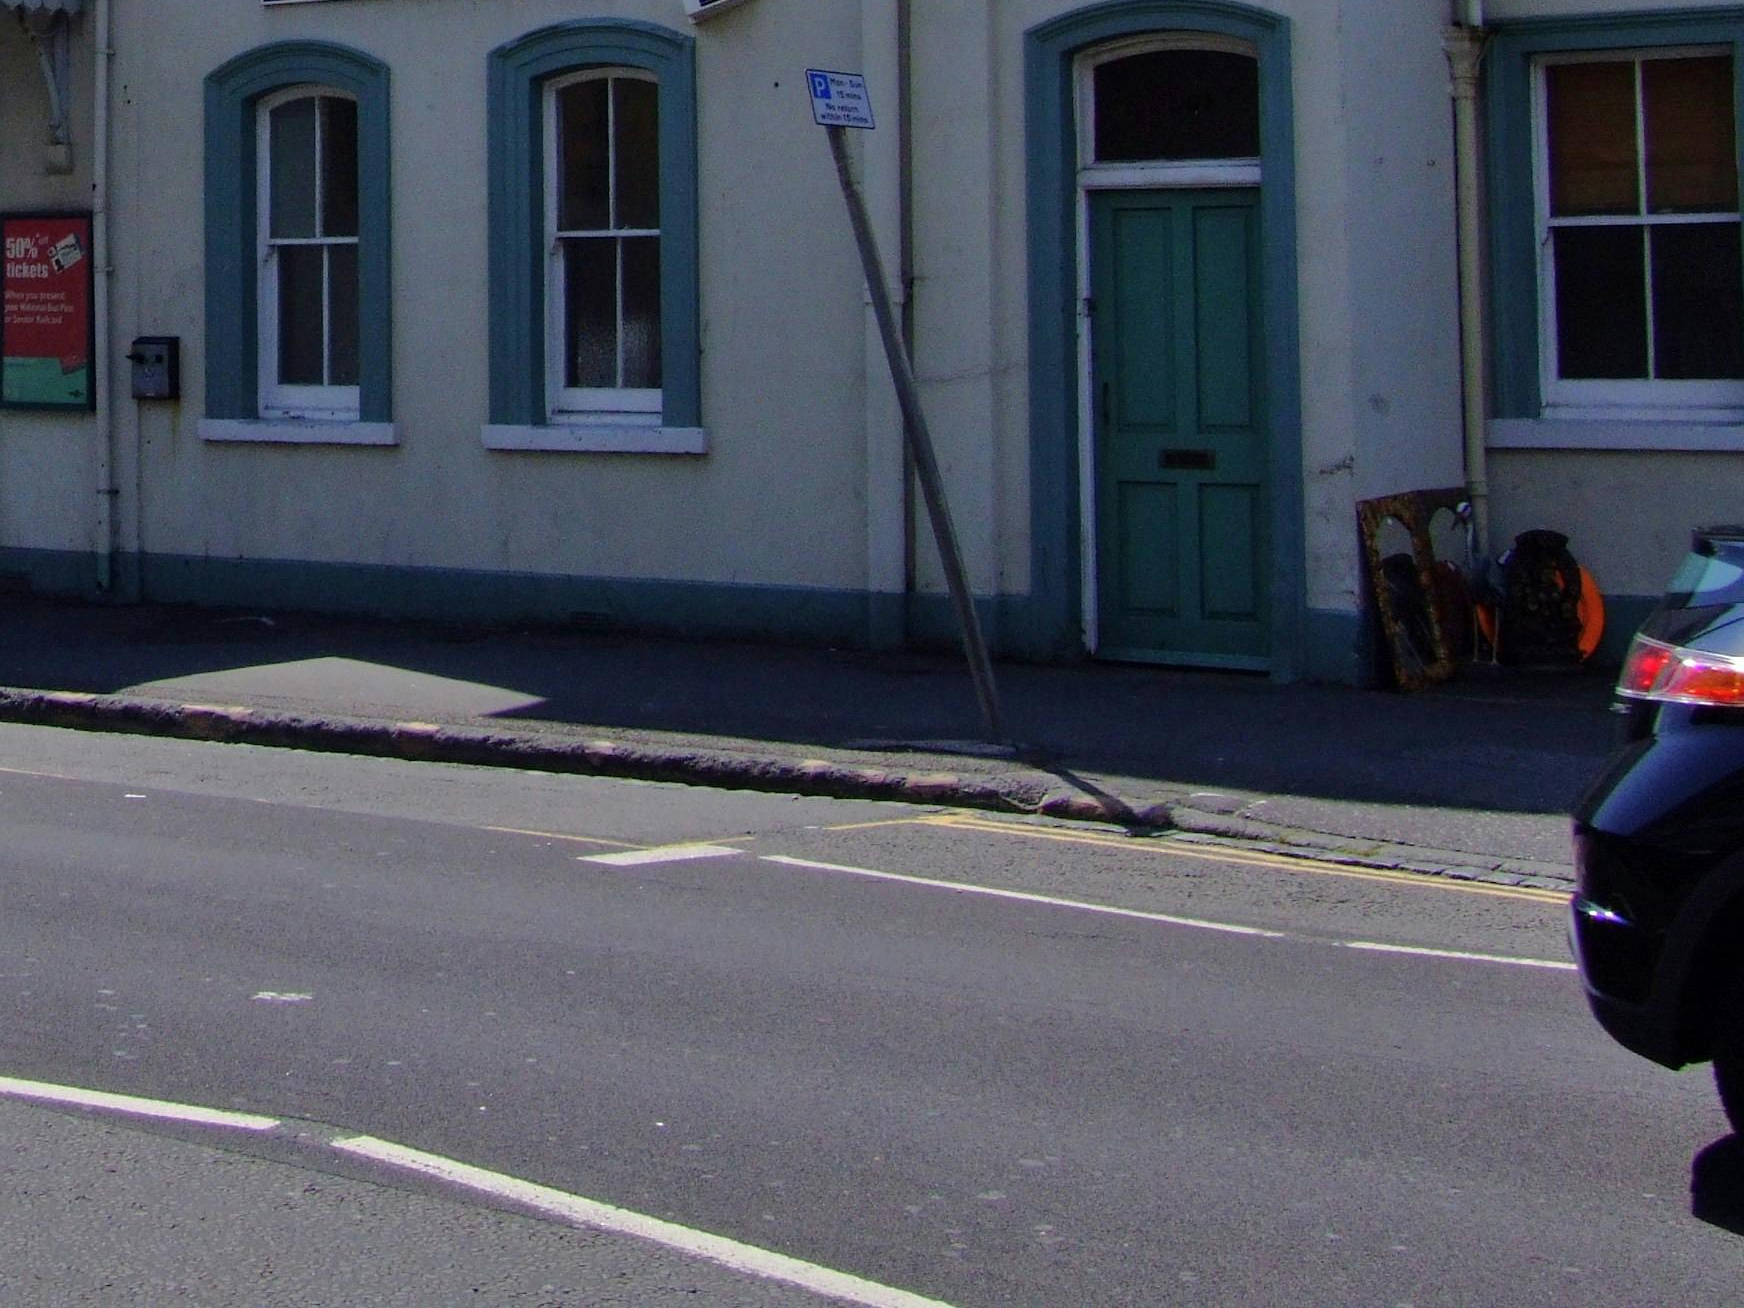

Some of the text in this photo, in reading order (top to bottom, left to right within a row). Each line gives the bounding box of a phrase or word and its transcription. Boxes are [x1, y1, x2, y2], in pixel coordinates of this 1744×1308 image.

[815, 77, 826, 97] P
[825, 103, 859, 113] No return
[6, 262, 49, 279] tickets
